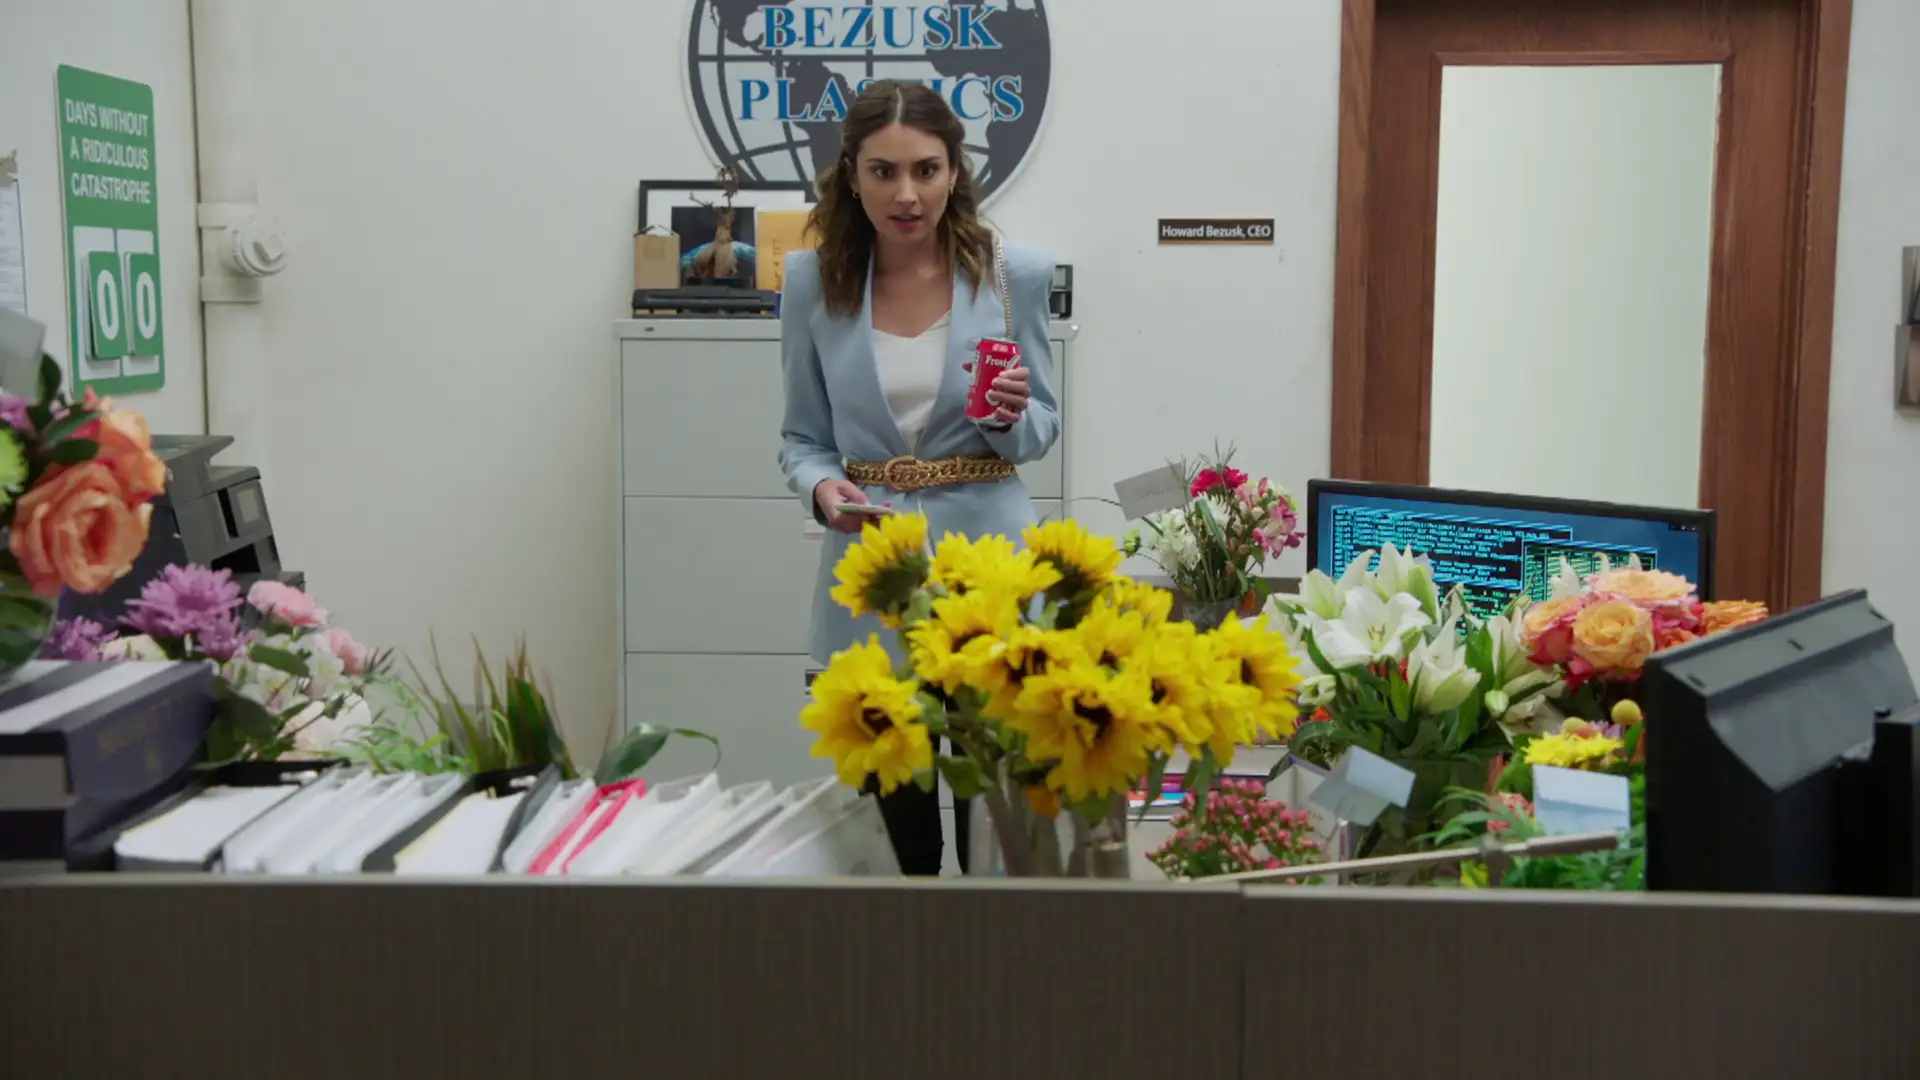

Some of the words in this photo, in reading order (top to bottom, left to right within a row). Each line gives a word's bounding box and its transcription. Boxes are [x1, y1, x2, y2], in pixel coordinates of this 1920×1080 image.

[760, 5, 1001, 49] BEZUSK
[738, 76, 1023, 121] PLACS
[65, 98, 98, 127] DAYS
[98, 106, 148, 137] WITHOUT
[70, 136, 80, 160] A
[82, 138, 149, 171] RIDICULOUS
[71, 173, 151, 204] CATASTROPHE
[1162, 225, 1204, 237] Howard
[1206, 225, 1246, 239] Bezusk,
[1247, 225, 1271, 237] CEO
